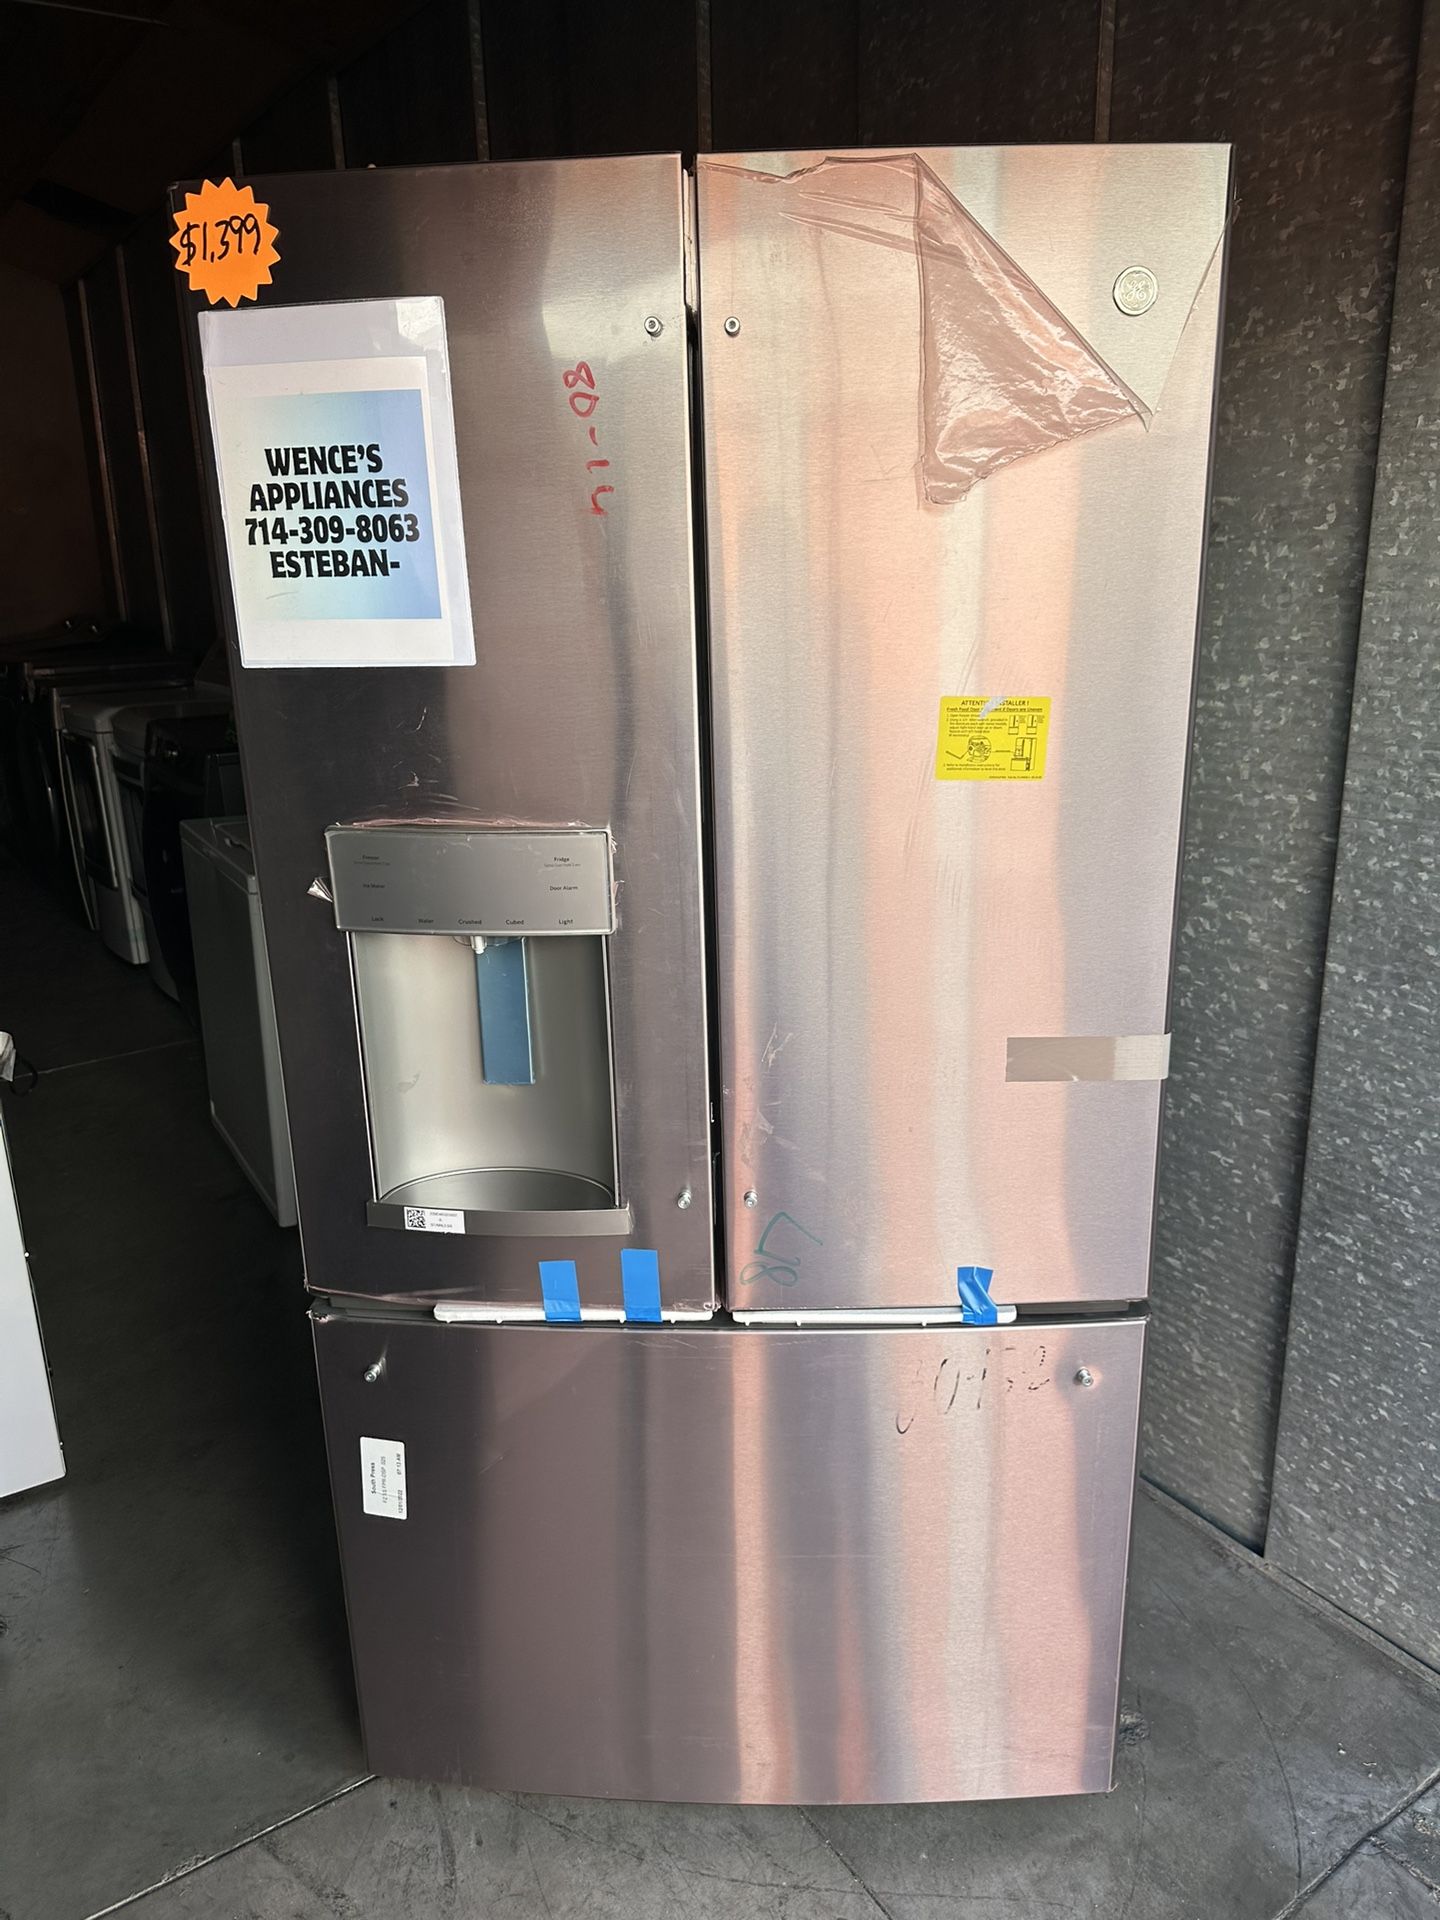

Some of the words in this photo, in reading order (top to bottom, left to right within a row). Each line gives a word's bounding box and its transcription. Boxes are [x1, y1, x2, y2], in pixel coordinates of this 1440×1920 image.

[179, 213, 261, 266] $1,399
[264, 444, 383, 476] WENCE'S
[250, 479, 409, 512] APPLIANCES
[245, 514, 420, 545] 714-309-8063
[270, 549, 400, 578] ESTEBAN-
[558, 918, 574, 926] Light
